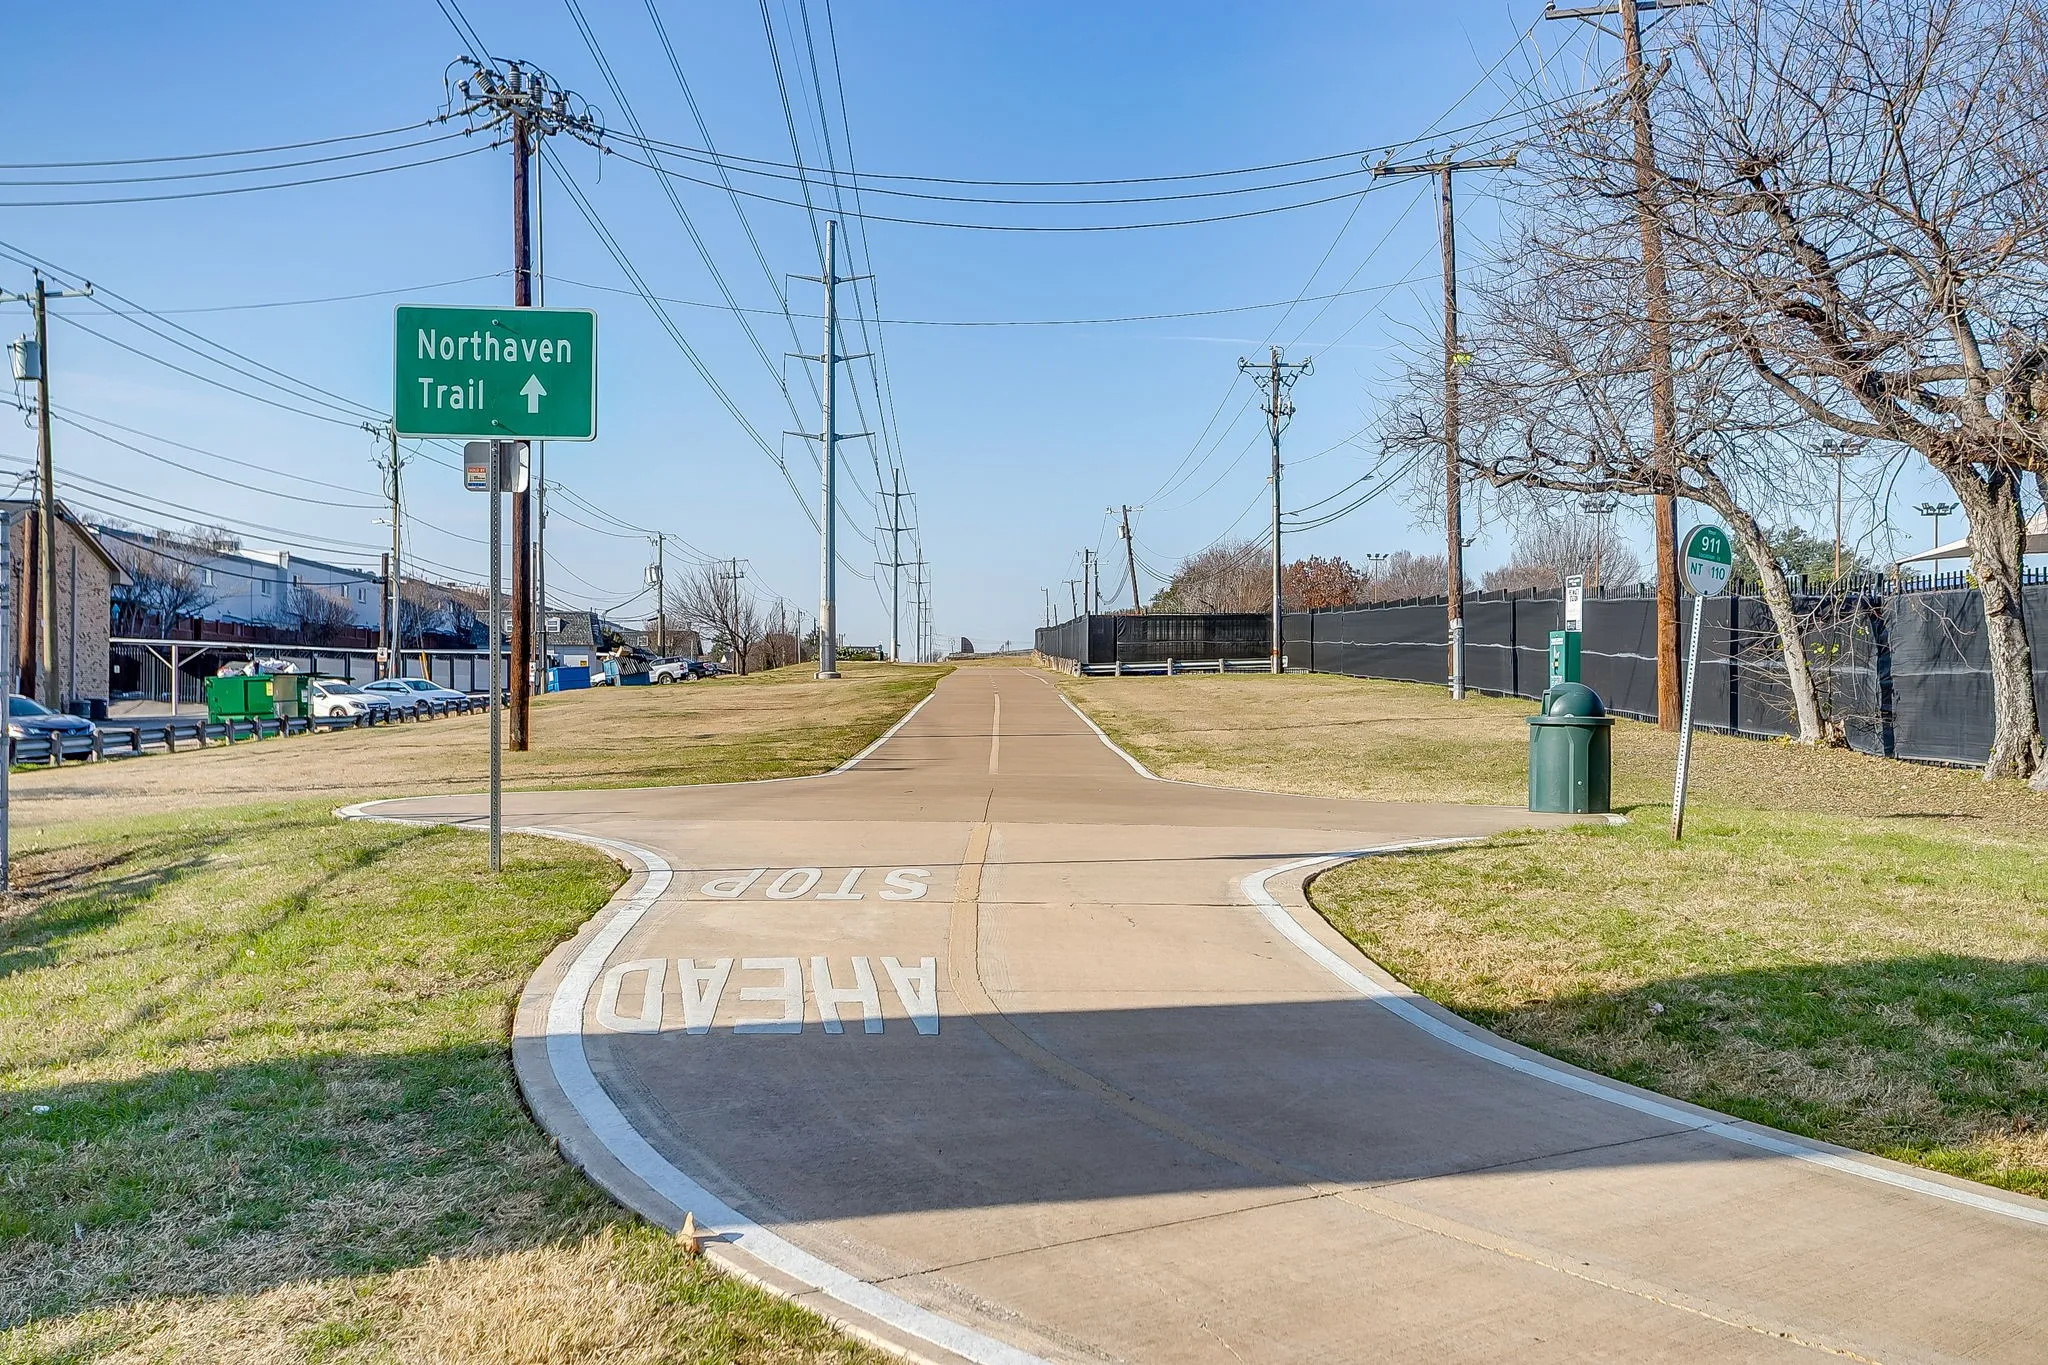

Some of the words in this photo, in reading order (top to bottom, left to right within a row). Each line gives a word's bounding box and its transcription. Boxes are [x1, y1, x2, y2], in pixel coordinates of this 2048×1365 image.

[418, 328, 572, 363] Northaven
[418, 377, 484, 410] Trail
[1701, 536, 1721, 554] 911
[1690, 562, 1703, 576] NT
[1711, 566, 1725, 580] 110
[700, 867, 932, 900] STOP
[595, 955, 940, 1035] AHEAD
